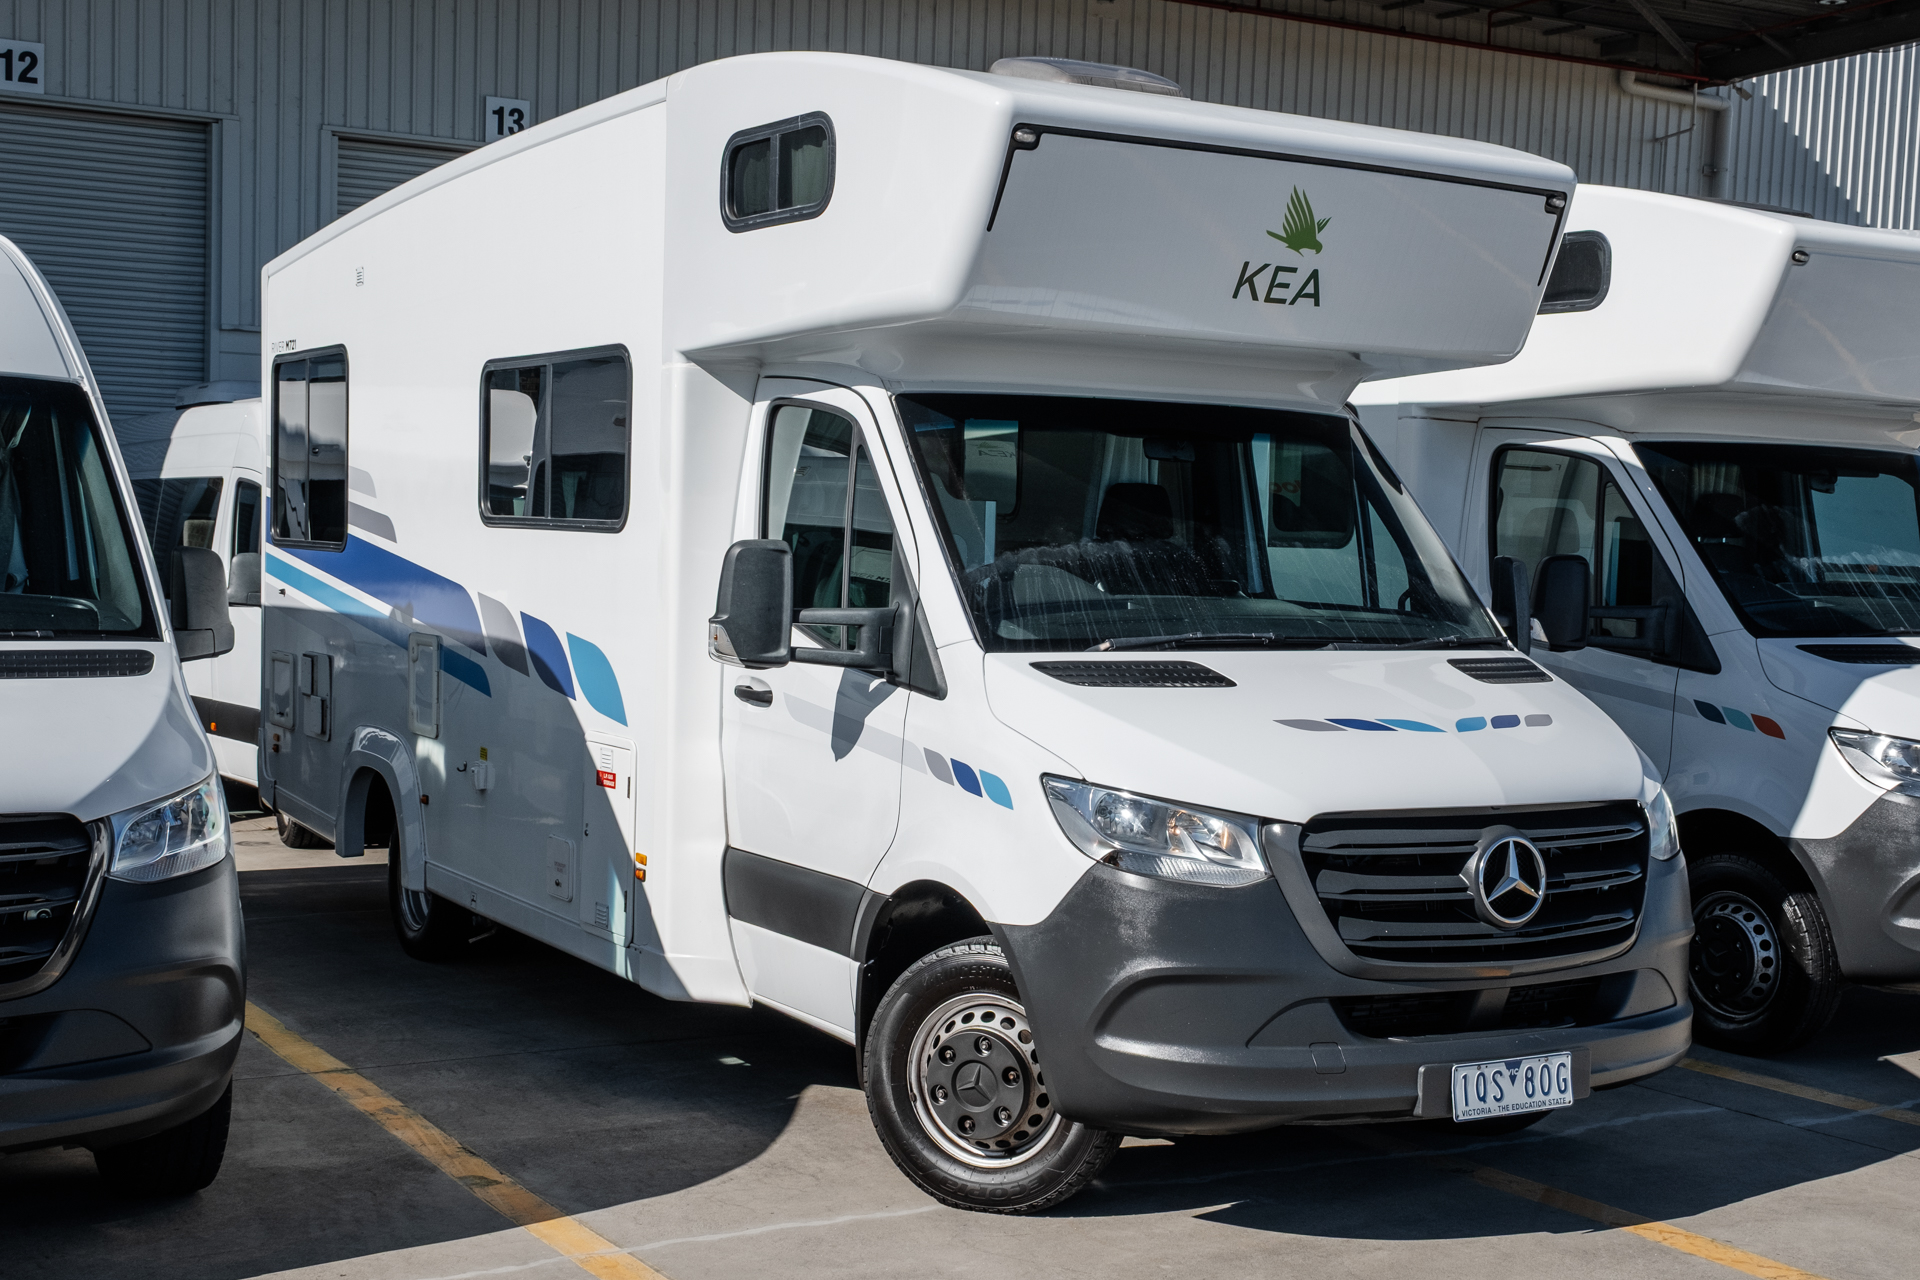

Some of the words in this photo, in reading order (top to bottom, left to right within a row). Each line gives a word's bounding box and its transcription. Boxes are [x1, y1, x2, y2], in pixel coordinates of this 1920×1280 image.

[0, 48, 38, 84] 12
[492, 106, 525, 136] 13
[1232, 261, 1320, 307] KEA
[1461, 1069, 1504, 1107] 1QS
[1509, 1068, 1519, 1076] VIC
[1462, 1107, 1492, 1117] VICTORIA
[1498, 1104, 1510, 1112] THE
[1512, 1100, 1546, 1111] EDUCATION
[1548, 1097, 1567, 1106] STATE
